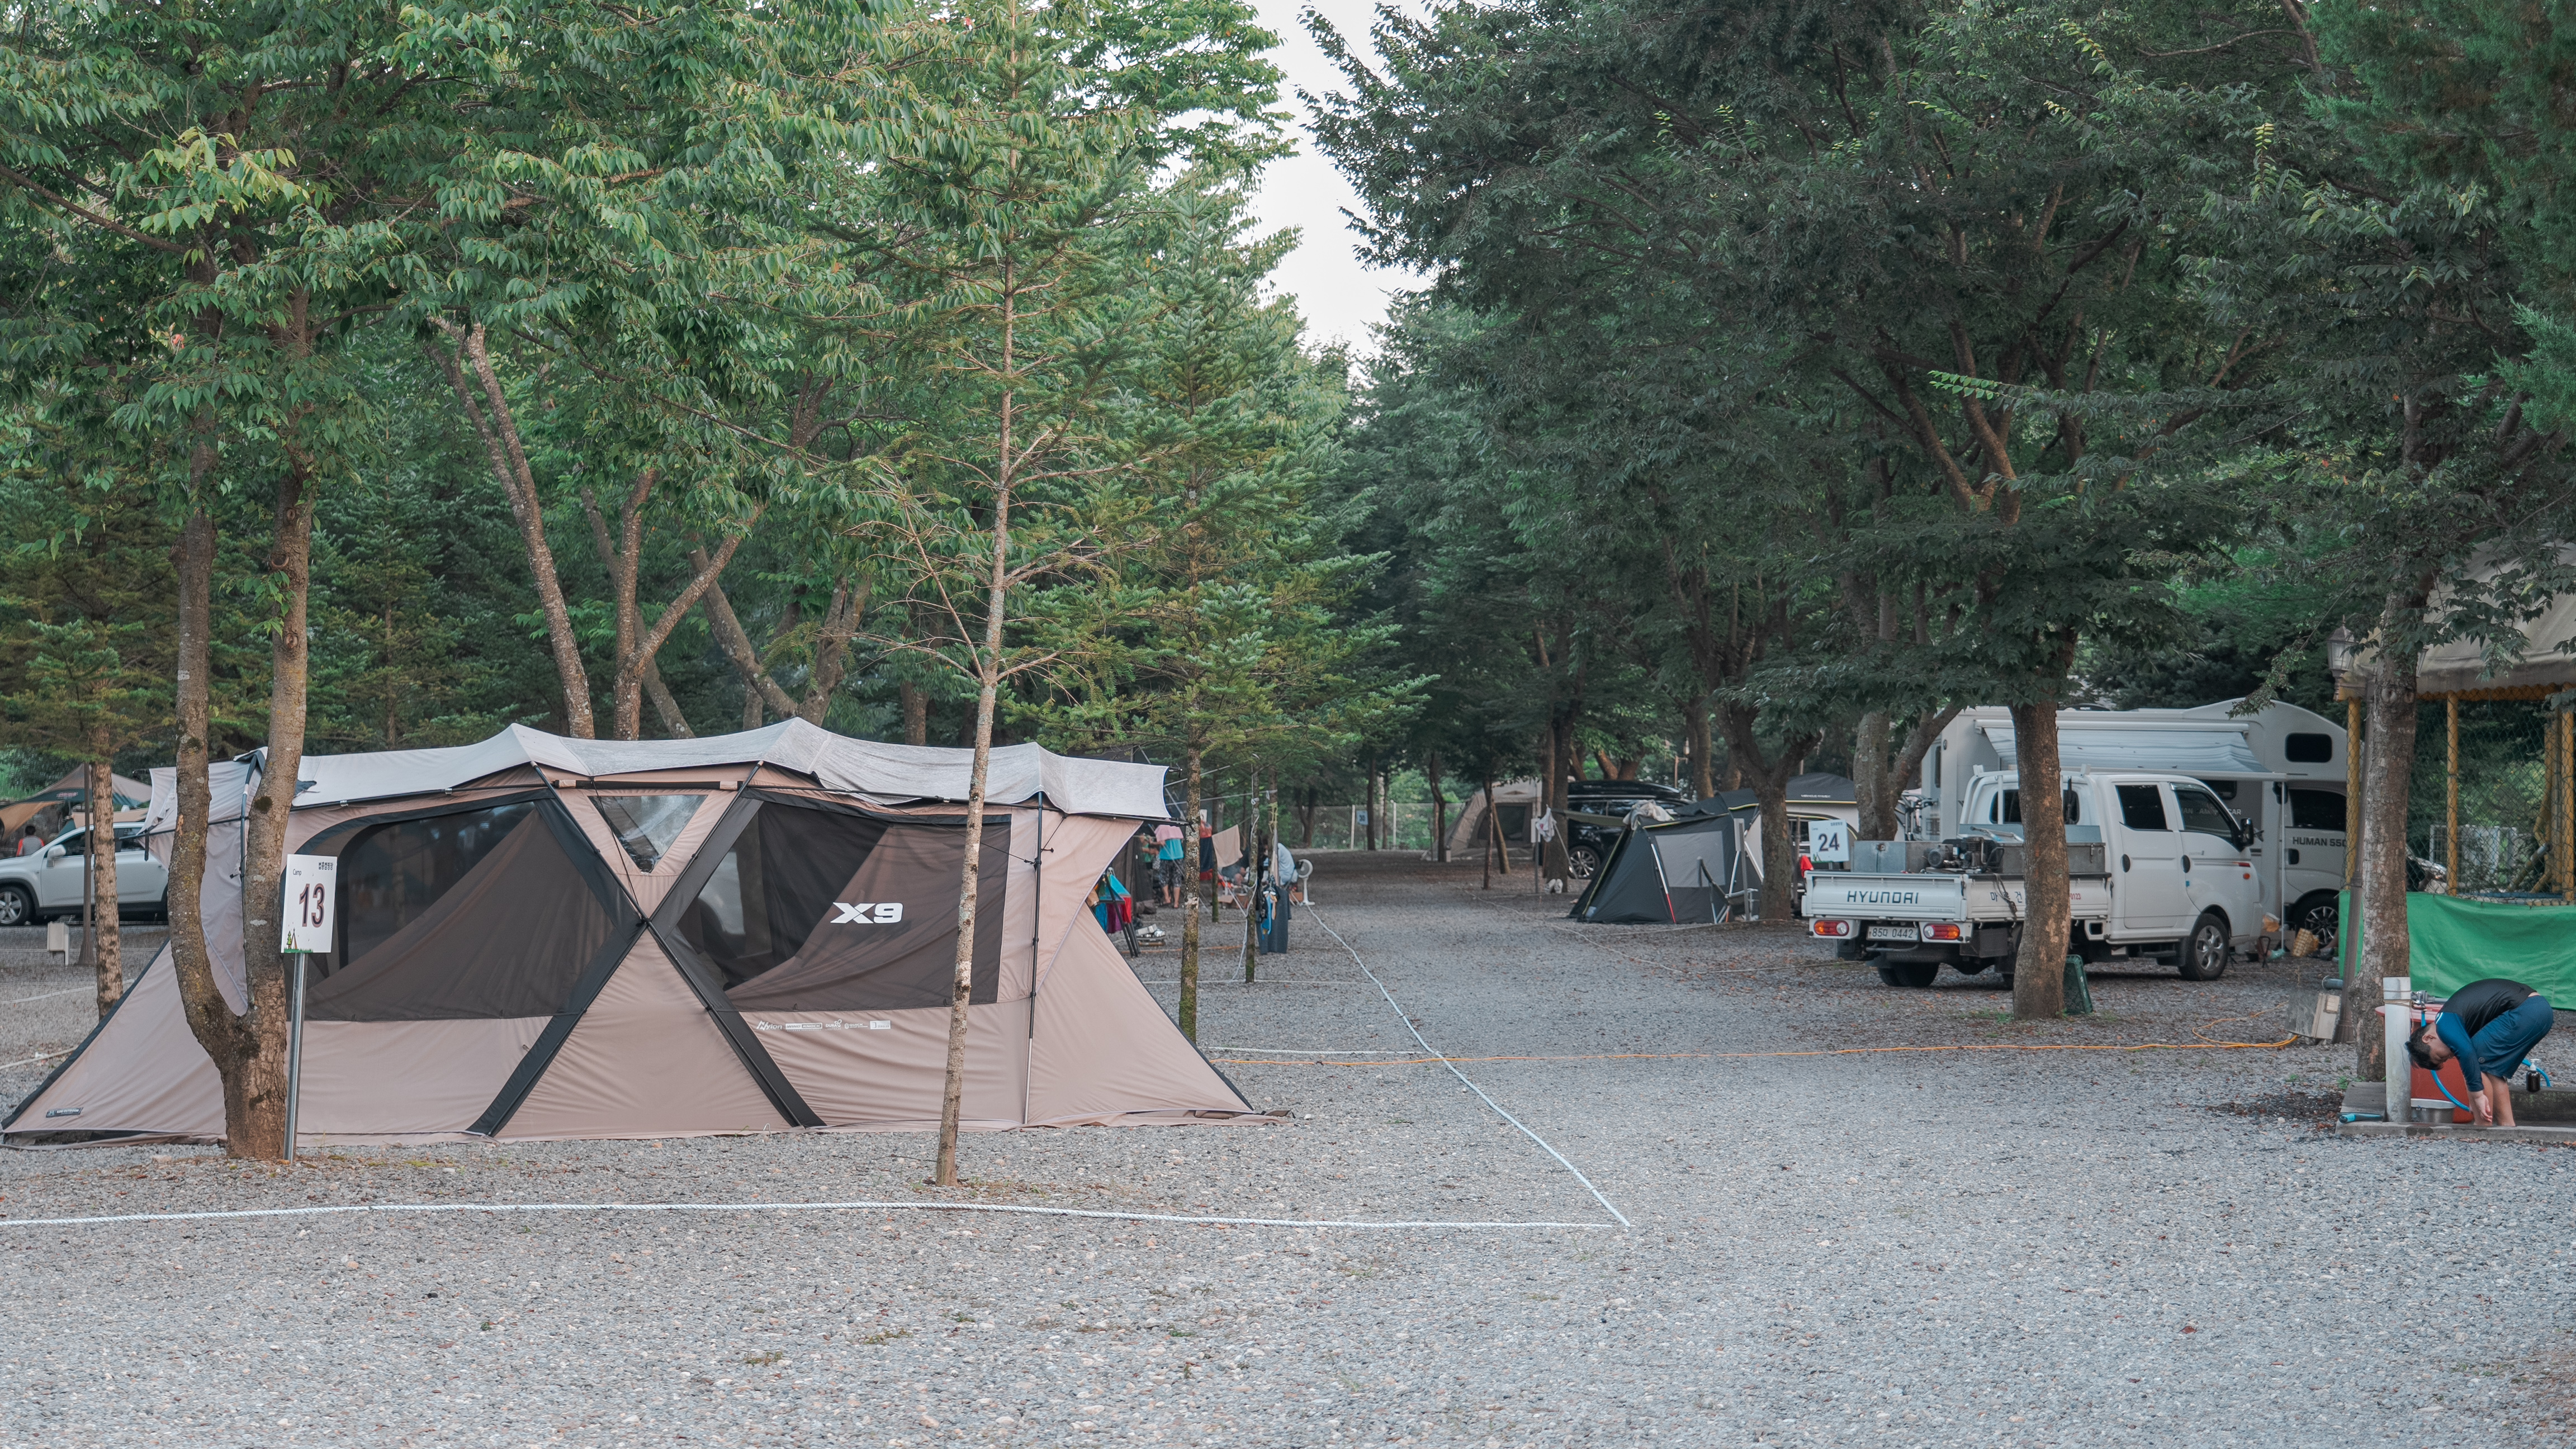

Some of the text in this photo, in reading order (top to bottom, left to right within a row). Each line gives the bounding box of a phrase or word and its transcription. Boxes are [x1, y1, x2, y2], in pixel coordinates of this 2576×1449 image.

[1818, 832, 1840, 851] 24
[2293, 837, 2327, 846] HUMAN
[1846, 891, 1919, 904] HYUNDAI
[299, 883, 325, 927] 13
[830, 902, 903, 924] X9
[1892, 929, 1914, 938] 0442
[756, 1020, 783, 1030] Nylon
